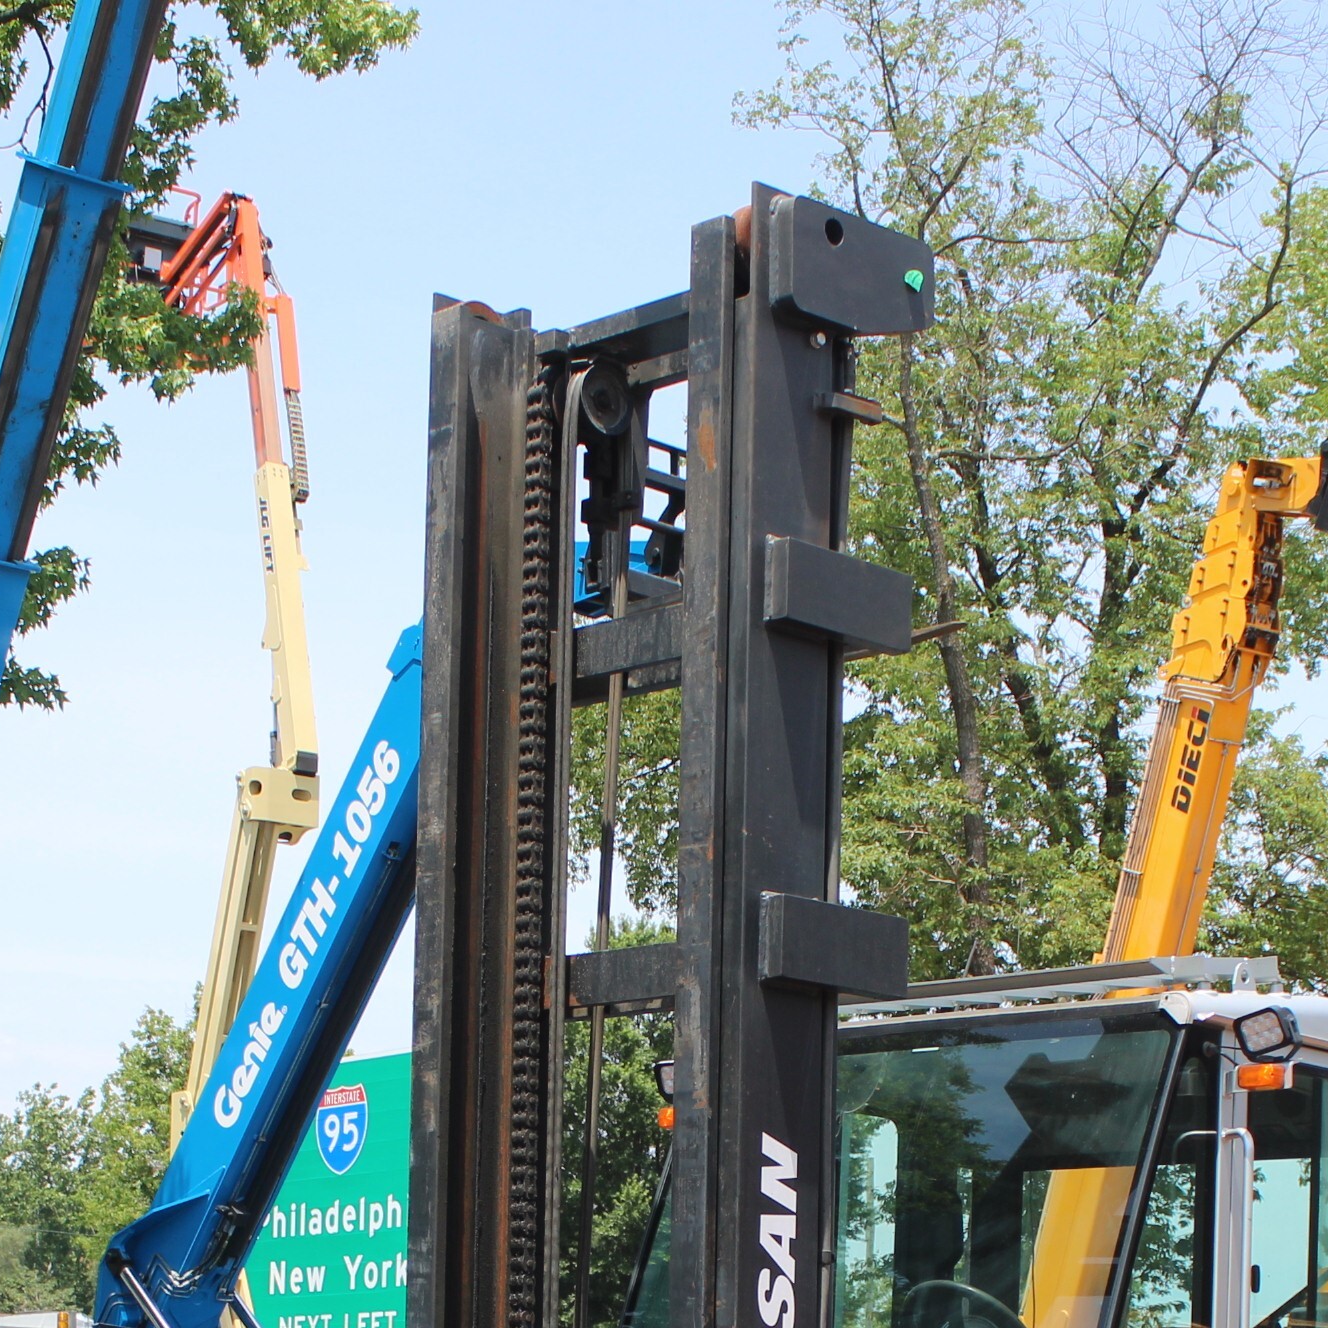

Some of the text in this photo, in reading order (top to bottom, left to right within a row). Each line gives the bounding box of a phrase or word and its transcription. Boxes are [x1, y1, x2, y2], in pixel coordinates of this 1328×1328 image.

[259, 497, 274, 572] JLG LIFT
[213, 740, 400, 1128] Genie GTH-1056
[324, 1089, 360, 1105] INTERSTATE
[324, 1111, 358, 1153] 95
[269, 1252, 407, 1295] New York
